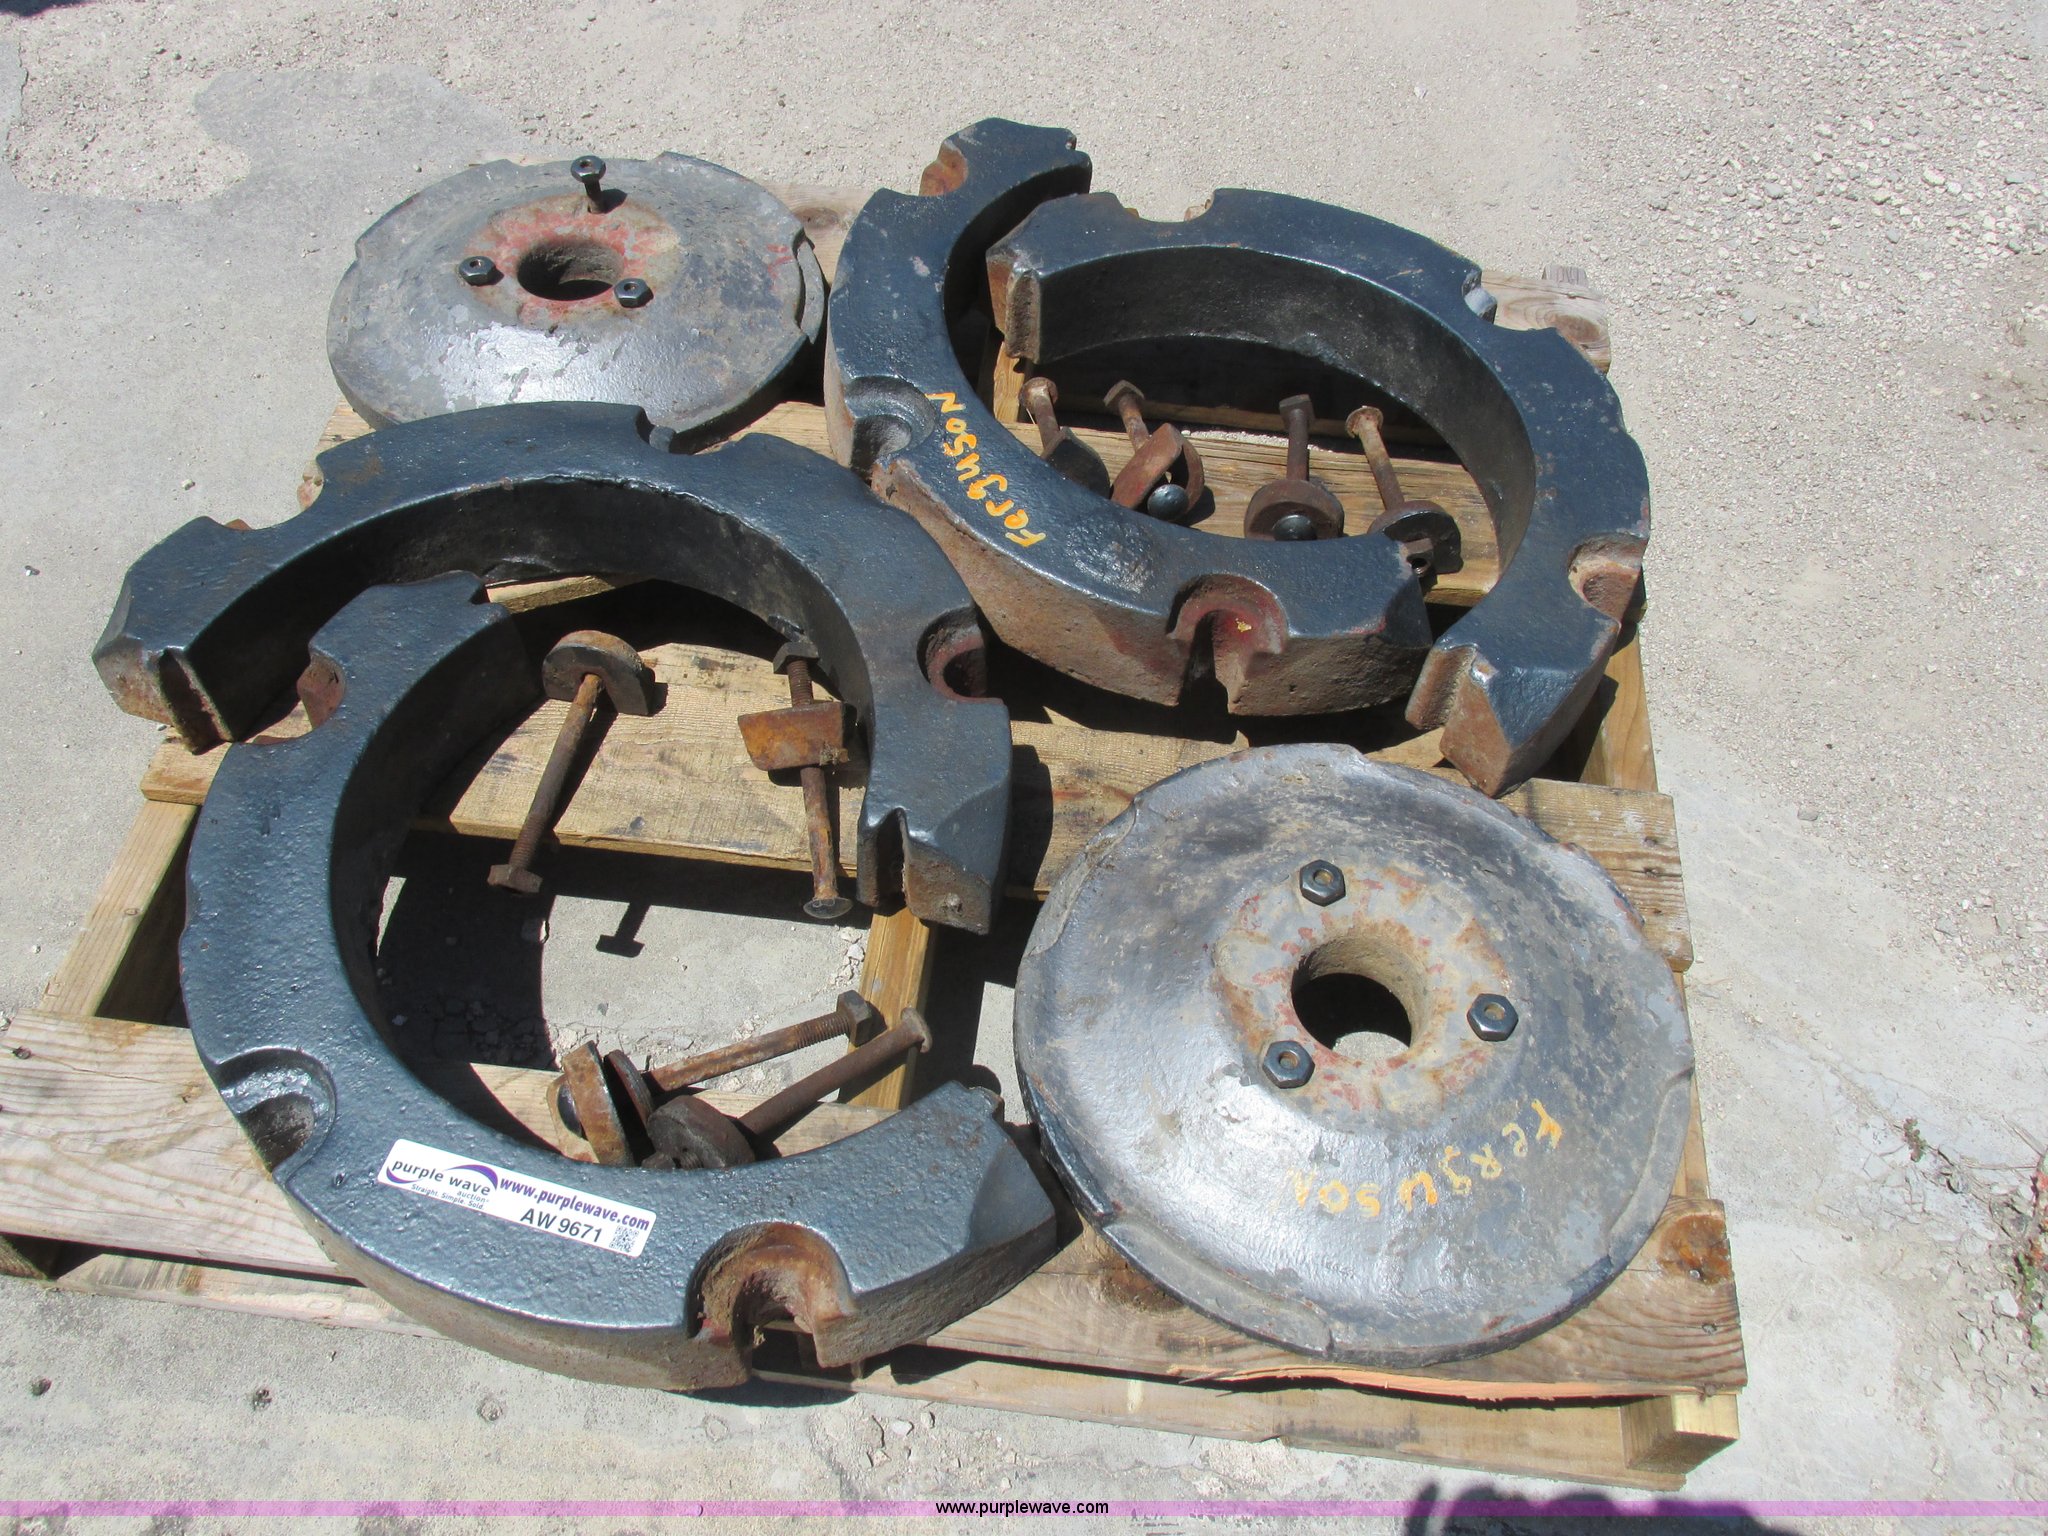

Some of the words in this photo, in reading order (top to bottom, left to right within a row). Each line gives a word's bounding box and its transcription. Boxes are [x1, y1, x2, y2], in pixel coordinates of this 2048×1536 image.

[391, 1160, 444, 1182] purple
[449, 1176, 491, 1196] wave
[500, 1178, 650, 1231] www.purplewave.com
[520, 1208, 557, 1229] AW
[557, 1218, 603, 1243] 9671
